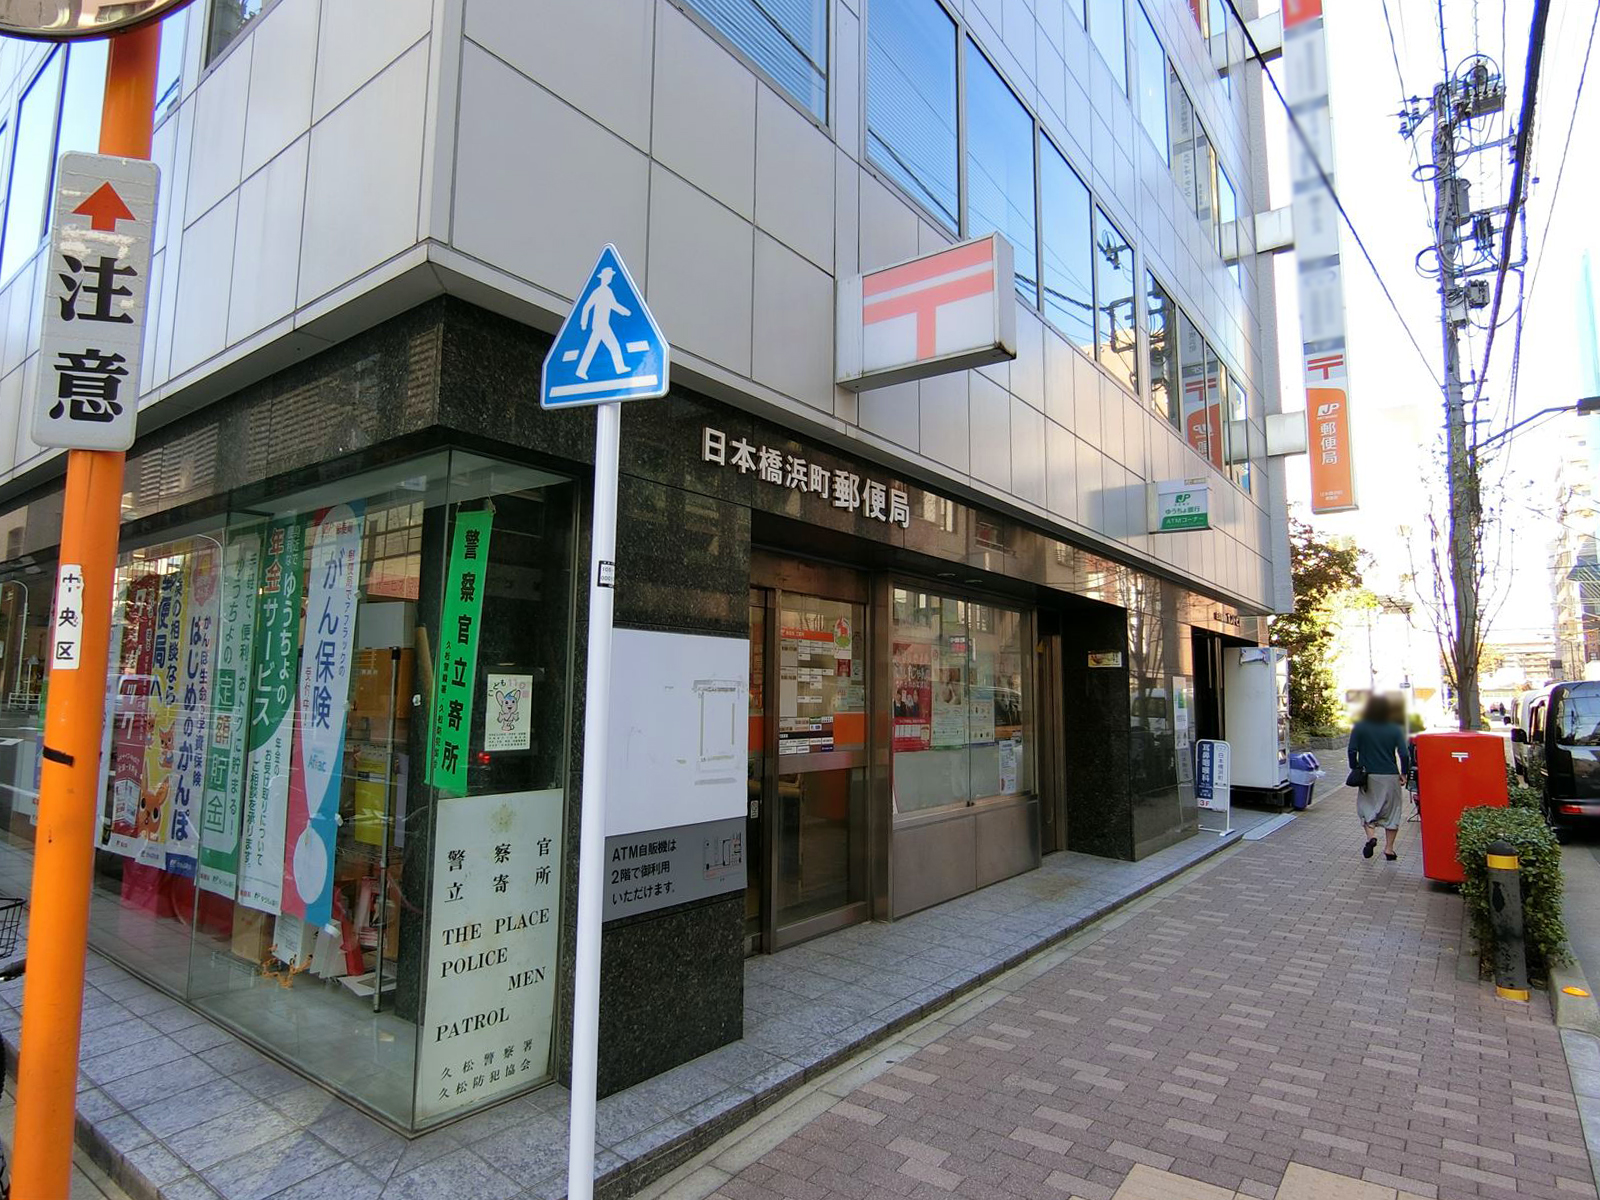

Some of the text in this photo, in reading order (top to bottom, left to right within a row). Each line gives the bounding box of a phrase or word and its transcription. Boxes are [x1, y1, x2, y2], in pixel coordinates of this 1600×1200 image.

[48, 254, 138, 424] 注意
[1319, 422, 1338, 465] 郵便局
[702, 426, 911, 530] 日本橋浜町郵便局
[1165, 505, 1201, 515] ゆうちょ銀行
[1166, 516, 1204, 525] ATMコーナー
[56, 574, 81, 660] 中央区
[253, 528, 284, 727] 年金サービス
[277, 572, 297, 704] ゆうちょの
[311, 547, 345, 730] がん保険
[441, 529, 480, 775] 警察官立寄所
[447, 837, 552, 872] 警察官
[612, 838, 677, 862] ATM自販機は
[444, 866, 552, 903] 立寄所
[611, 860, 670, 885] 2階で御利用
[612, 880, 676, 905] いただけます。
[442, 908, 550, 946] THE PLACE
[440, 947, 508, 978] POLICE
[508, 966, 547, 991] MEN
[435, 1007, 510, 1042] PATROL
